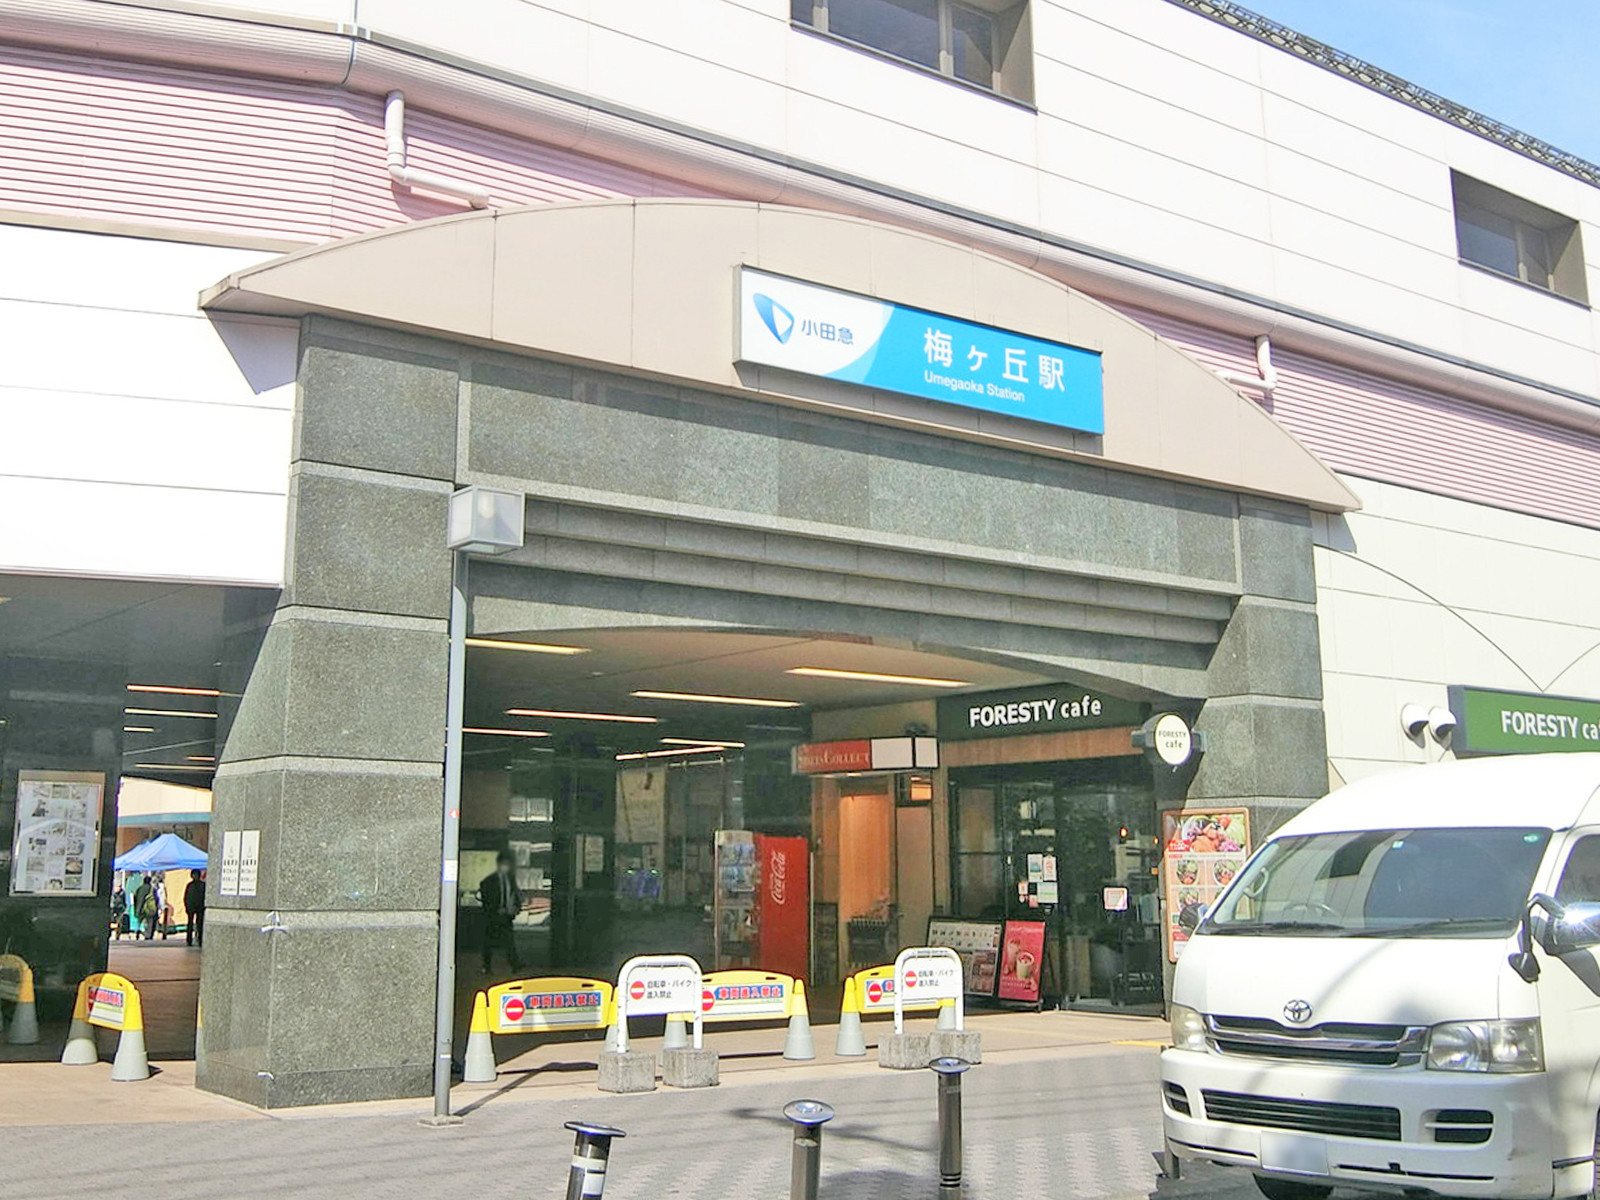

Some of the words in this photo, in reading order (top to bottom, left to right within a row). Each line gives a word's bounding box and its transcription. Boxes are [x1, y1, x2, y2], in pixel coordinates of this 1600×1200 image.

[801, 319, 854, 346] 小田急
[924, 370, 984, 394] Umegaoka
[987, 384, 1025, 402] Station
[969, 699, 1057, 728] FORESTY
[1061, 695, 1102, 719] cafe
[1501, 710, 1578, 739] FORESTY
[1582, 719, 1600, 740] ca
[1158, 729, 1187, 739] FORESTY
[1165, 739, 1183, 749] cafe
